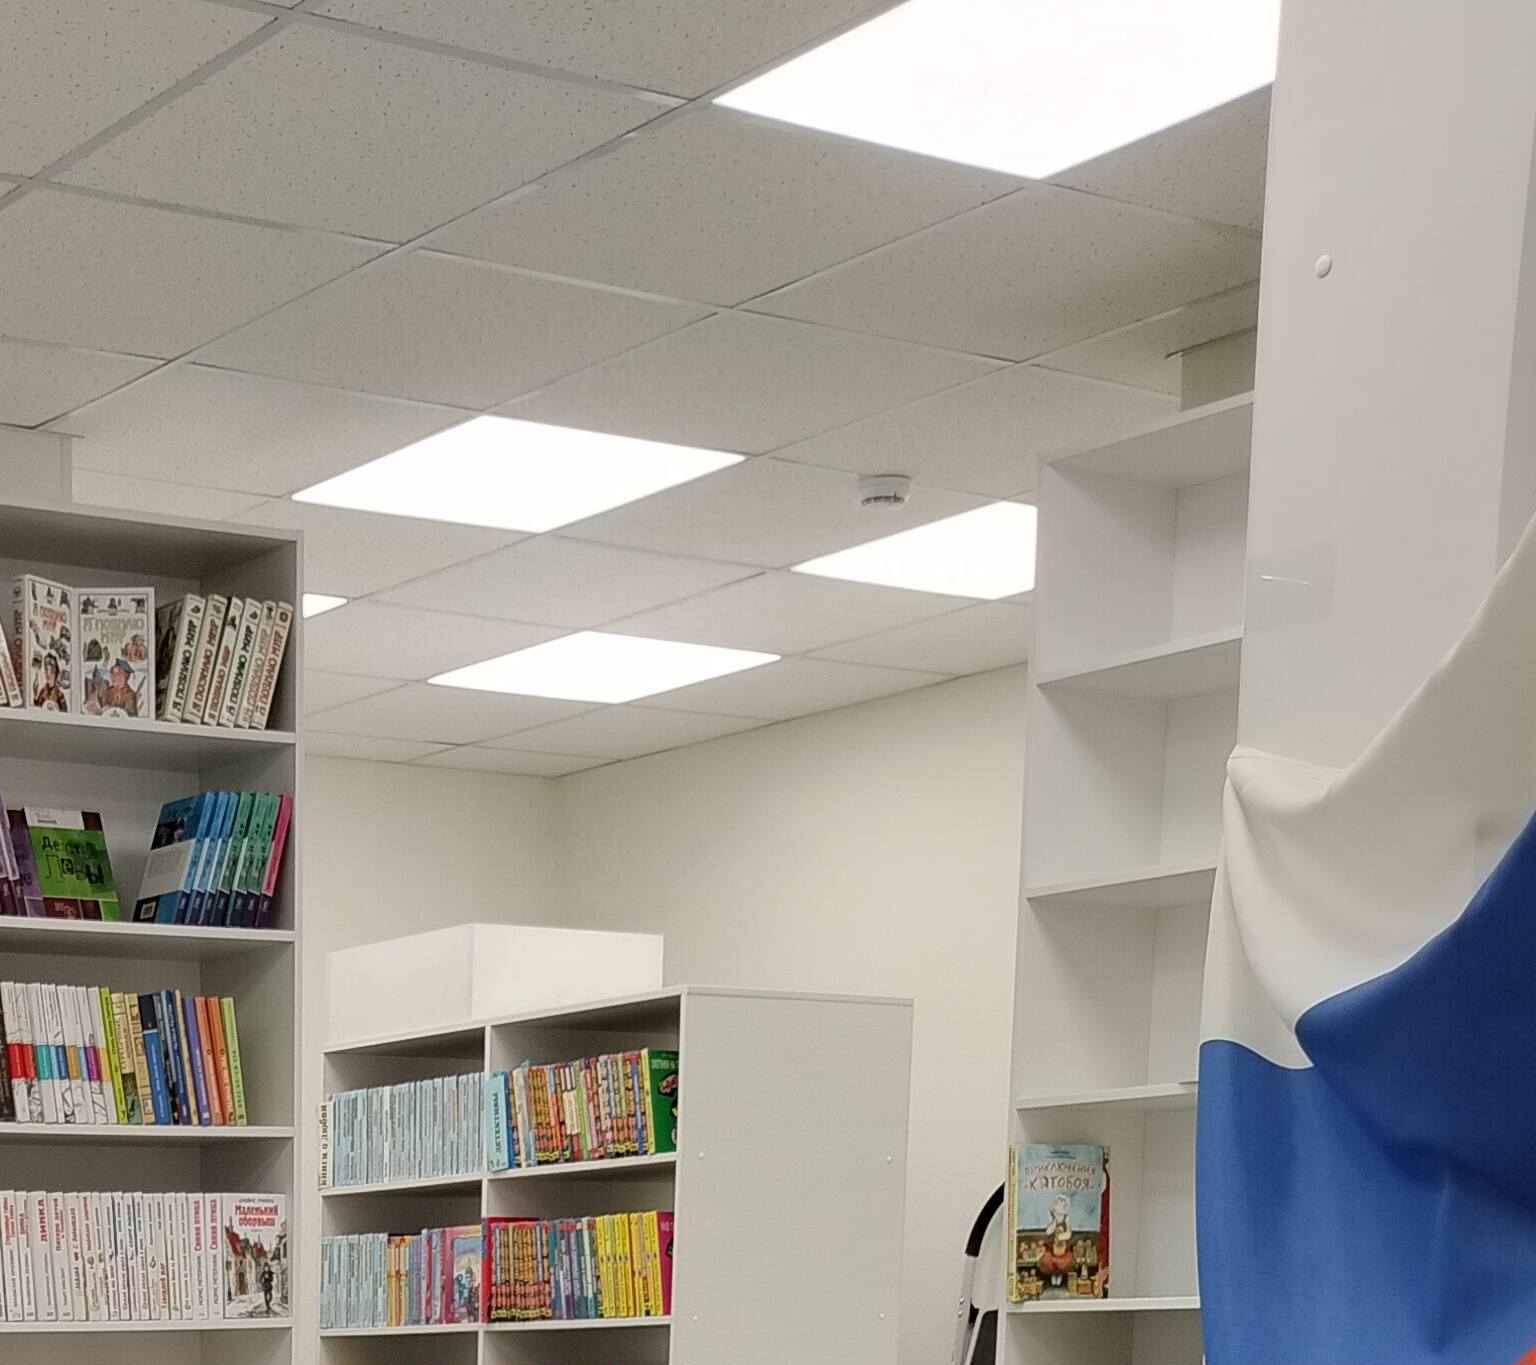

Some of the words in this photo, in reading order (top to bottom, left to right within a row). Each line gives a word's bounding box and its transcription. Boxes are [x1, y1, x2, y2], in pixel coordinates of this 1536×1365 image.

[235, 1205, 278, 1216] Маленький
[38, 1198, 47, 1242] ДИНКА
[239, 1216, 275, 1227] оборвыш
